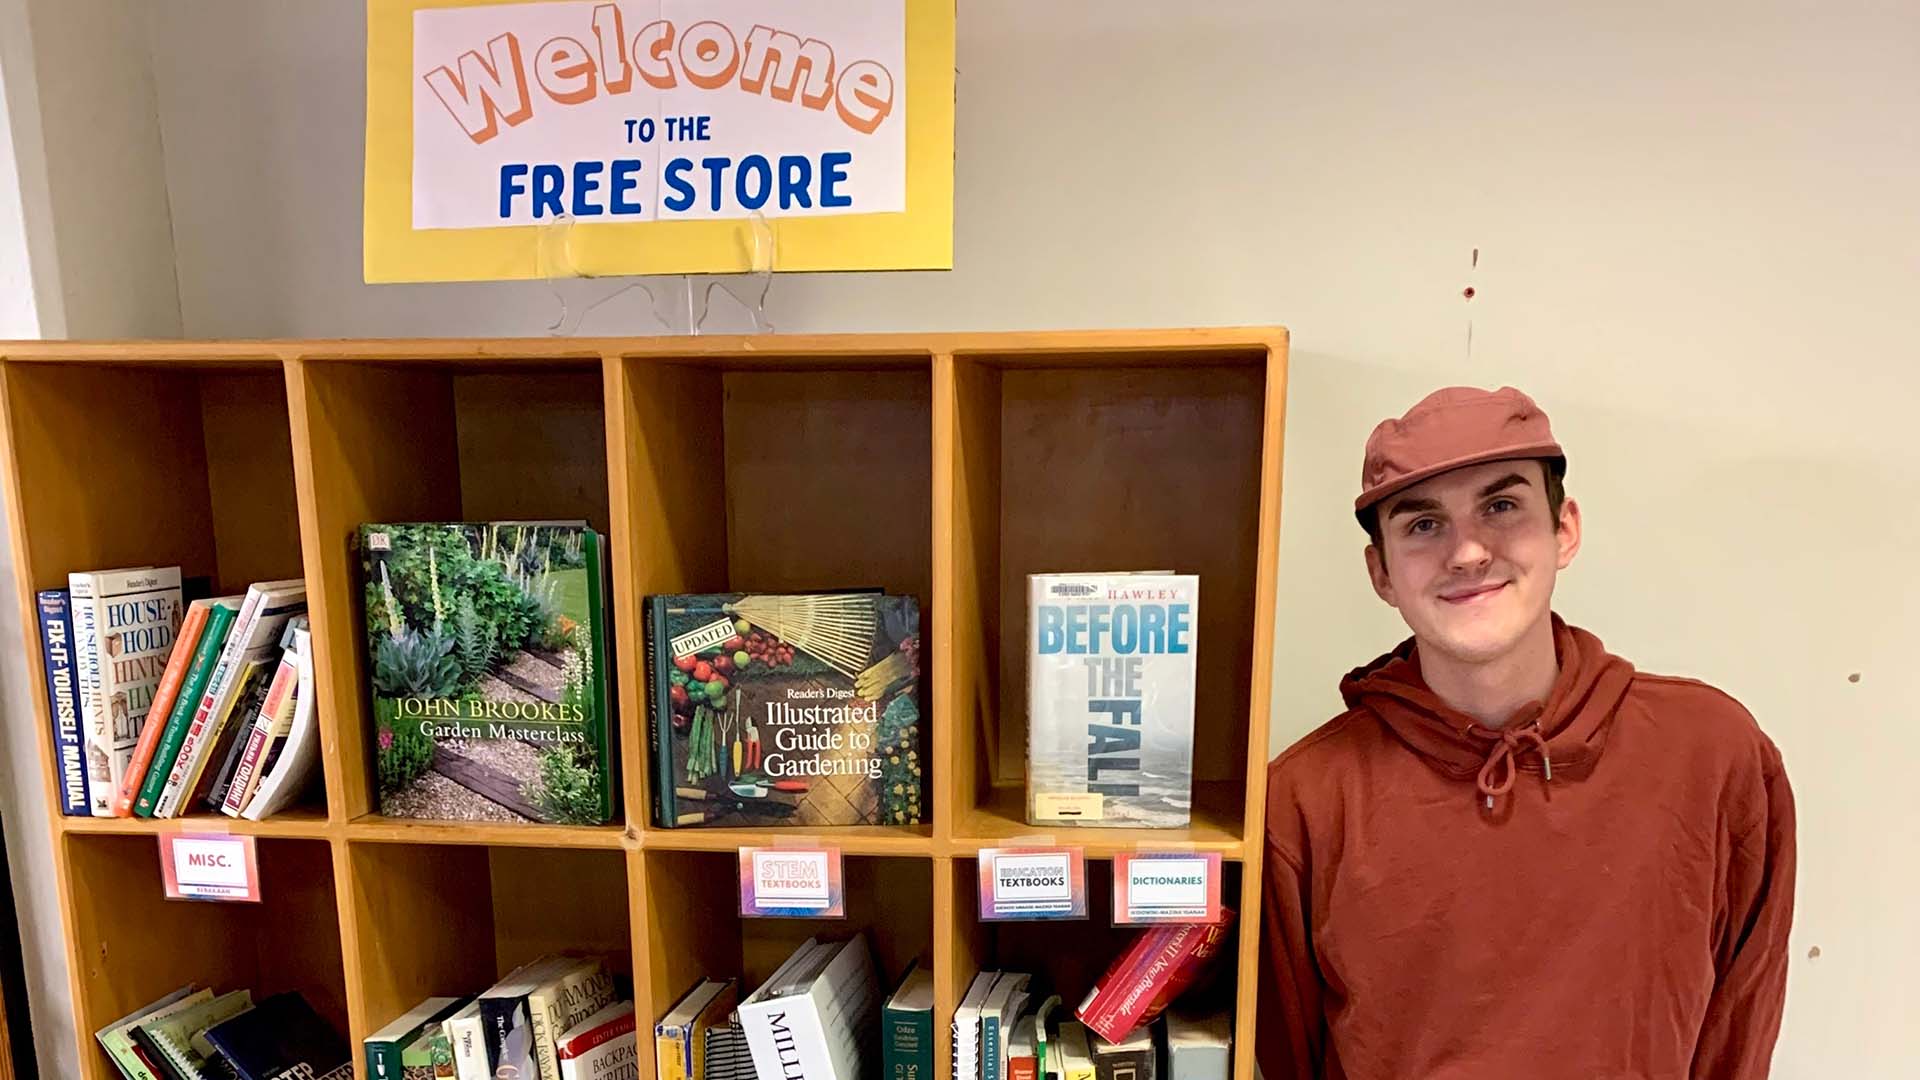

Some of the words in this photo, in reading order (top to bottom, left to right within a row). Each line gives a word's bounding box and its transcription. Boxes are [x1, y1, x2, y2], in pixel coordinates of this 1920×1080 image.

[423, 2, 894, 145] Welcome
[625, 119, 655, 142] TO
[665, 116, 711, 141] THE
[500, 159, 642, 218] FREE
[664, 152, 852, 211] STORE
[1108, 590, 1179, 600] HAWLEY
[123, 626, 170, 654] HOLD
[675, 623, 734, 656] UPDATED
[1038, 604, 1190, 655] BEFORE
[84, 606, 100, 690] HOUSEHOLD
[1084, 657, 1143, 697] THE
[787, 688, 825, 699] Reader's
[826, 687, 855, 700] Digest
[46, 619, 78, 743] FIX-IT-YOURSELF
[62, 745, 86, 810] MANUAL
[394, 697, 460, 721] JOHN
[470, 700, 584, 722] BROOKES
[766, 701, 878, 726] Illustrated
[420, 721, 481, 739] Garden
[489, 723, 584, 743] Masterclass
[775, 727, 842, 751] Guide
[849, 731, 870, 750] to
[763, 753, 883, 779] Gardening
[230, 762, 254, 806] ГОЛДИНГ
[189, 853, 231, 867] MISC.
[761, 860, 818, 879] STEM
[1000, 866, 1064, 878] EDUCATION
[761, 879, 822, 889] TEXTBOOKS
[1000, 877, 1065, 888] TEXTBOOKS
[1132, 876, 1203, 886] DICTIONARIES
[1147, 955, 1169, 981] New
[1121, 975, 1154, 1016] Riverside
